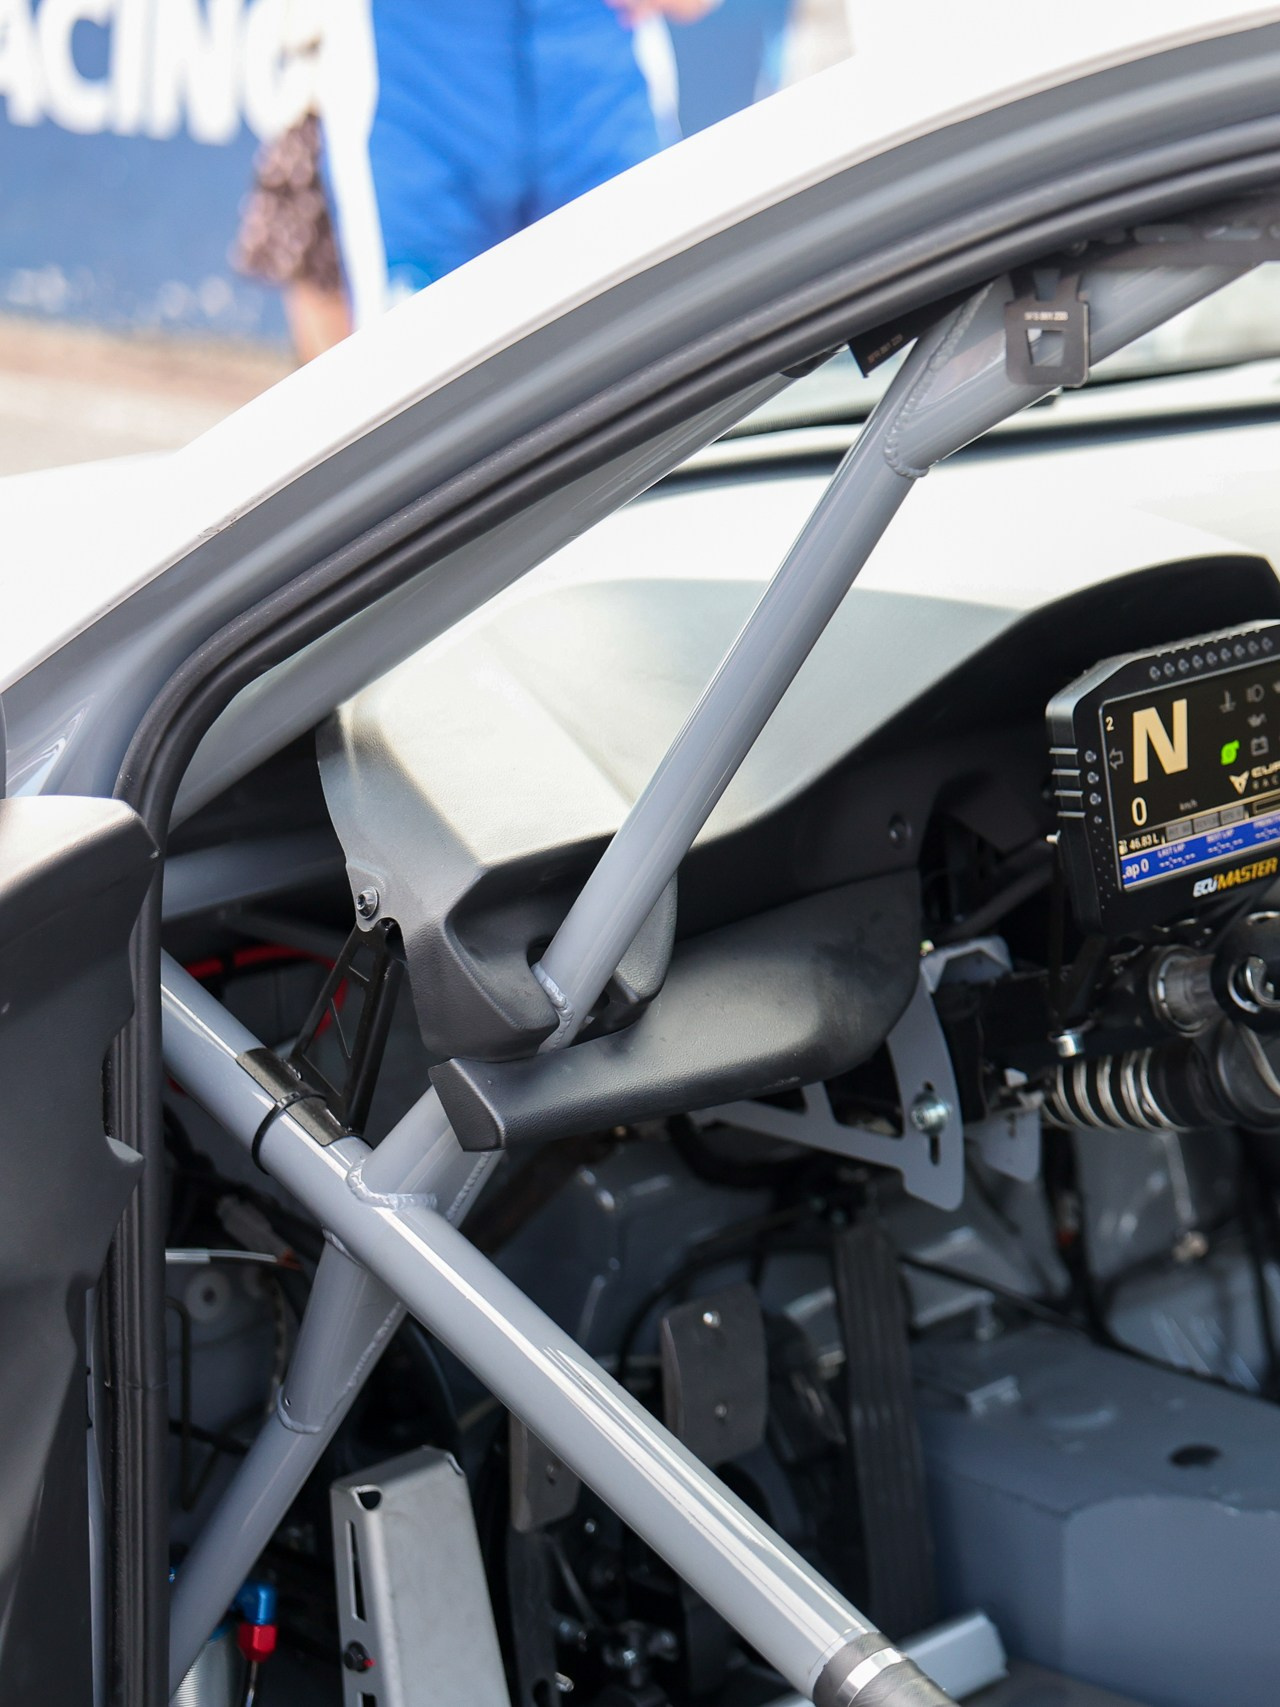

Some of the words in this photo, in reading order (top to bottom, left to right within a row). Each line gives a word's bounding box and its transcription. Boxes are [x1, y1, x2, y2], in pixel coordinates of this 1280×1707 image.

[1105, 716, 1114, 731] 2
[1132, 698, 1189, 785] N
[1131, 797, 1147, 826] 0
[1152, 833, 1160, 845] L
[1122, 865, 1140, 880] ap
[1140, 858, 1149, 873] 0
